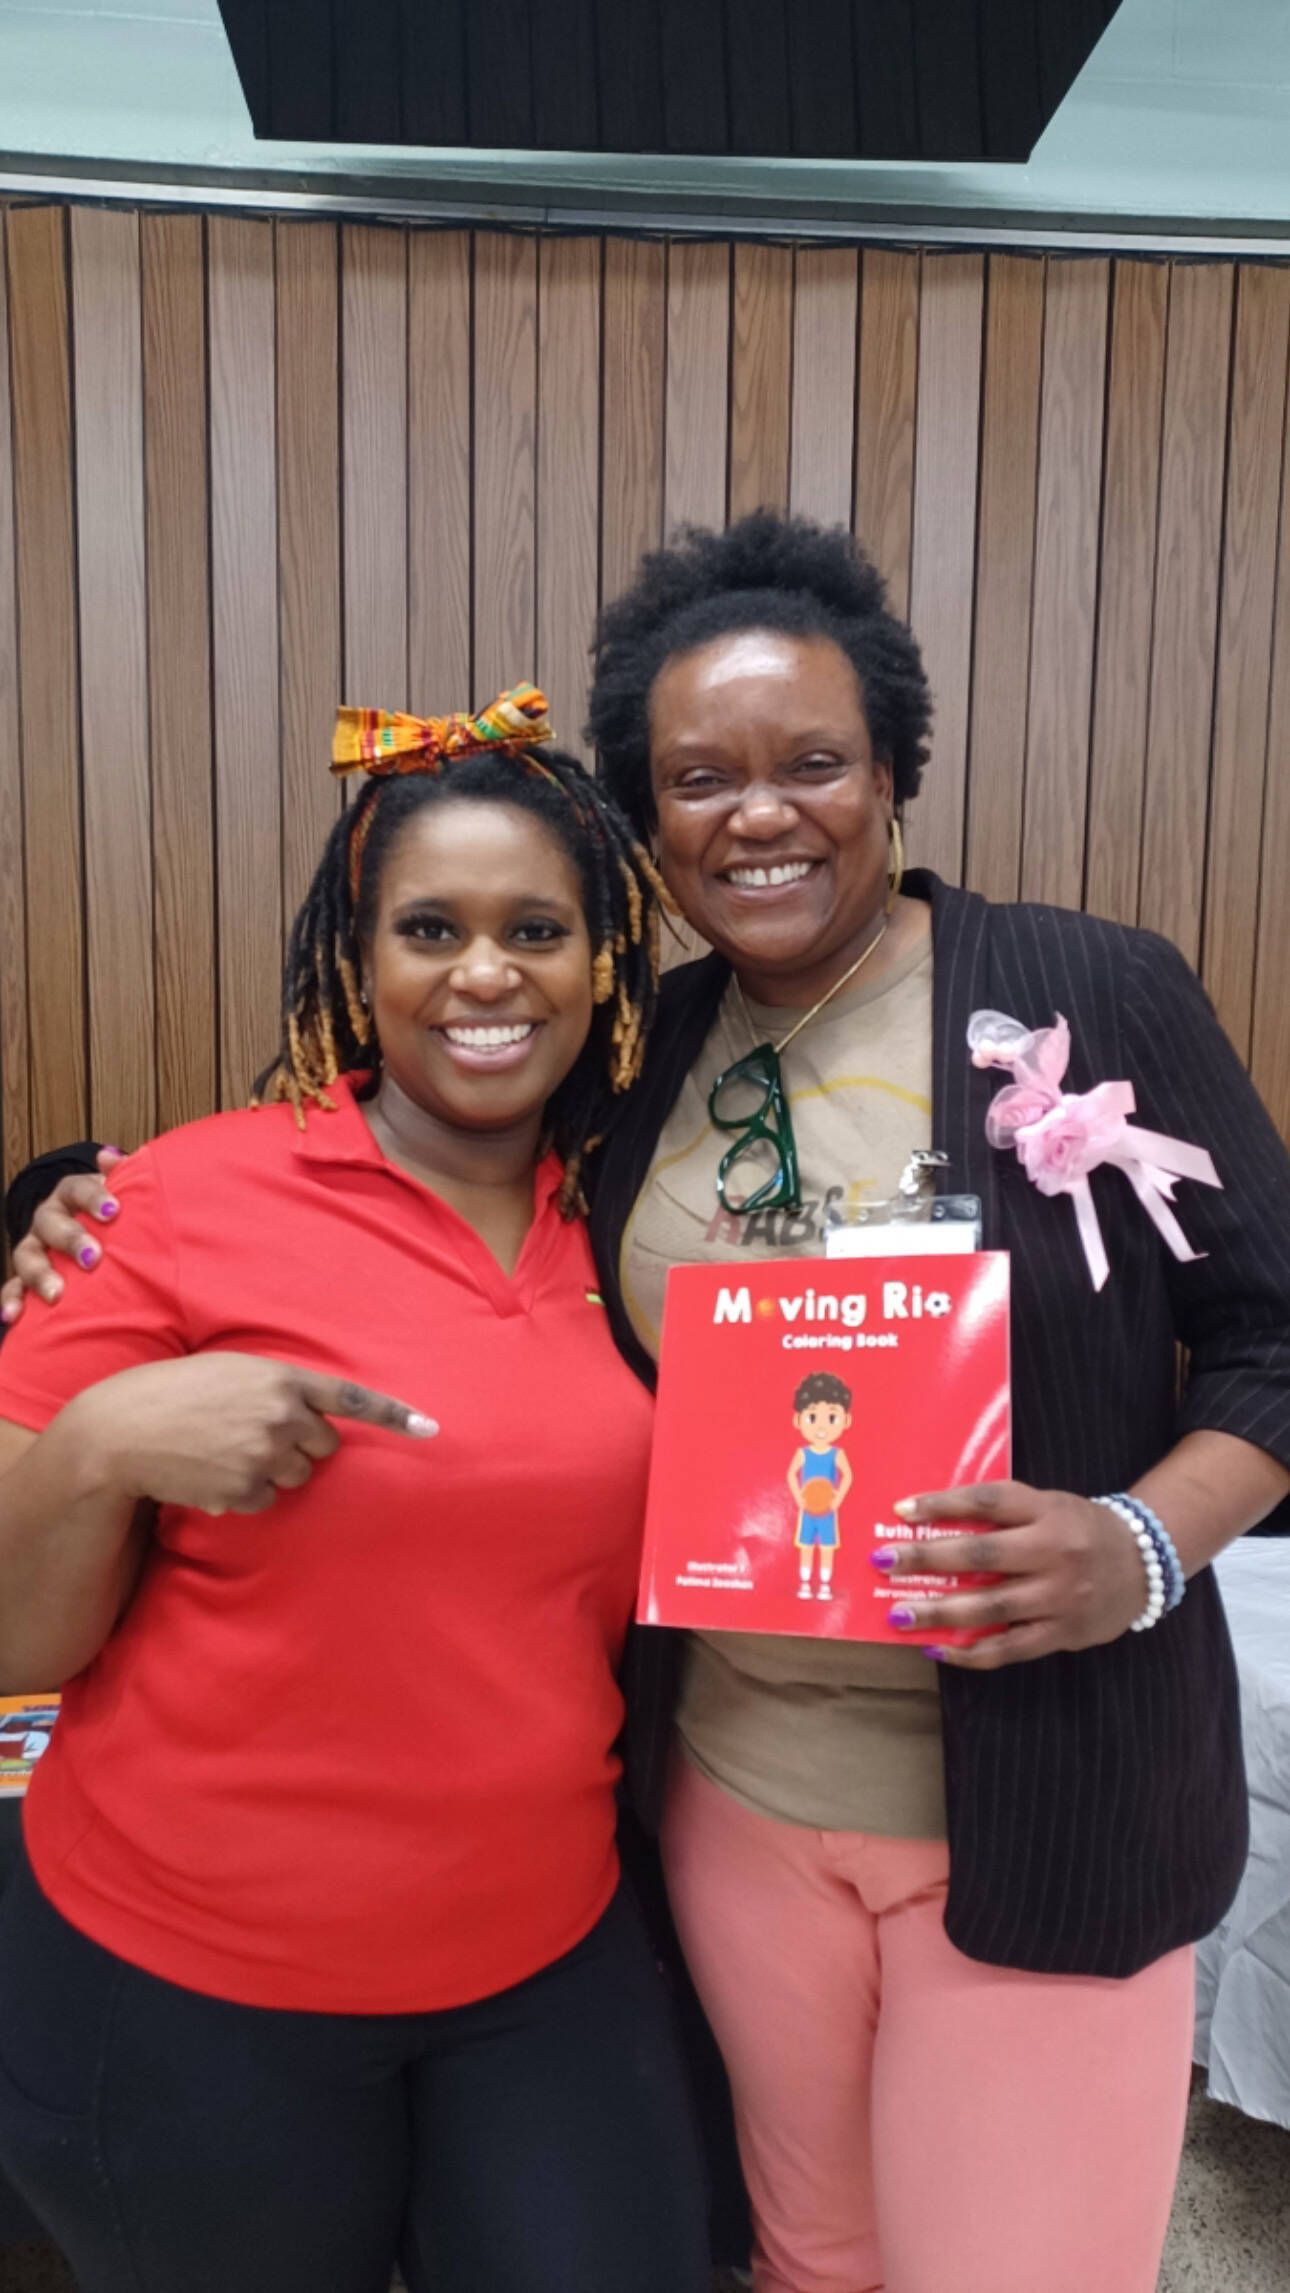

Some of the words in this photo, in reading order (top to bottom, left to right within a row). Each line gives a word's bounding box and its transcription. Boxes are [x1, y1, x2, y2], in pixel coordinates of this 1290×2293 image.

[782, 1333, 852, 1351] Coloring
[856, 1332, 898, 1348] Book
[874, 1523, 913, 1539] Ruth
